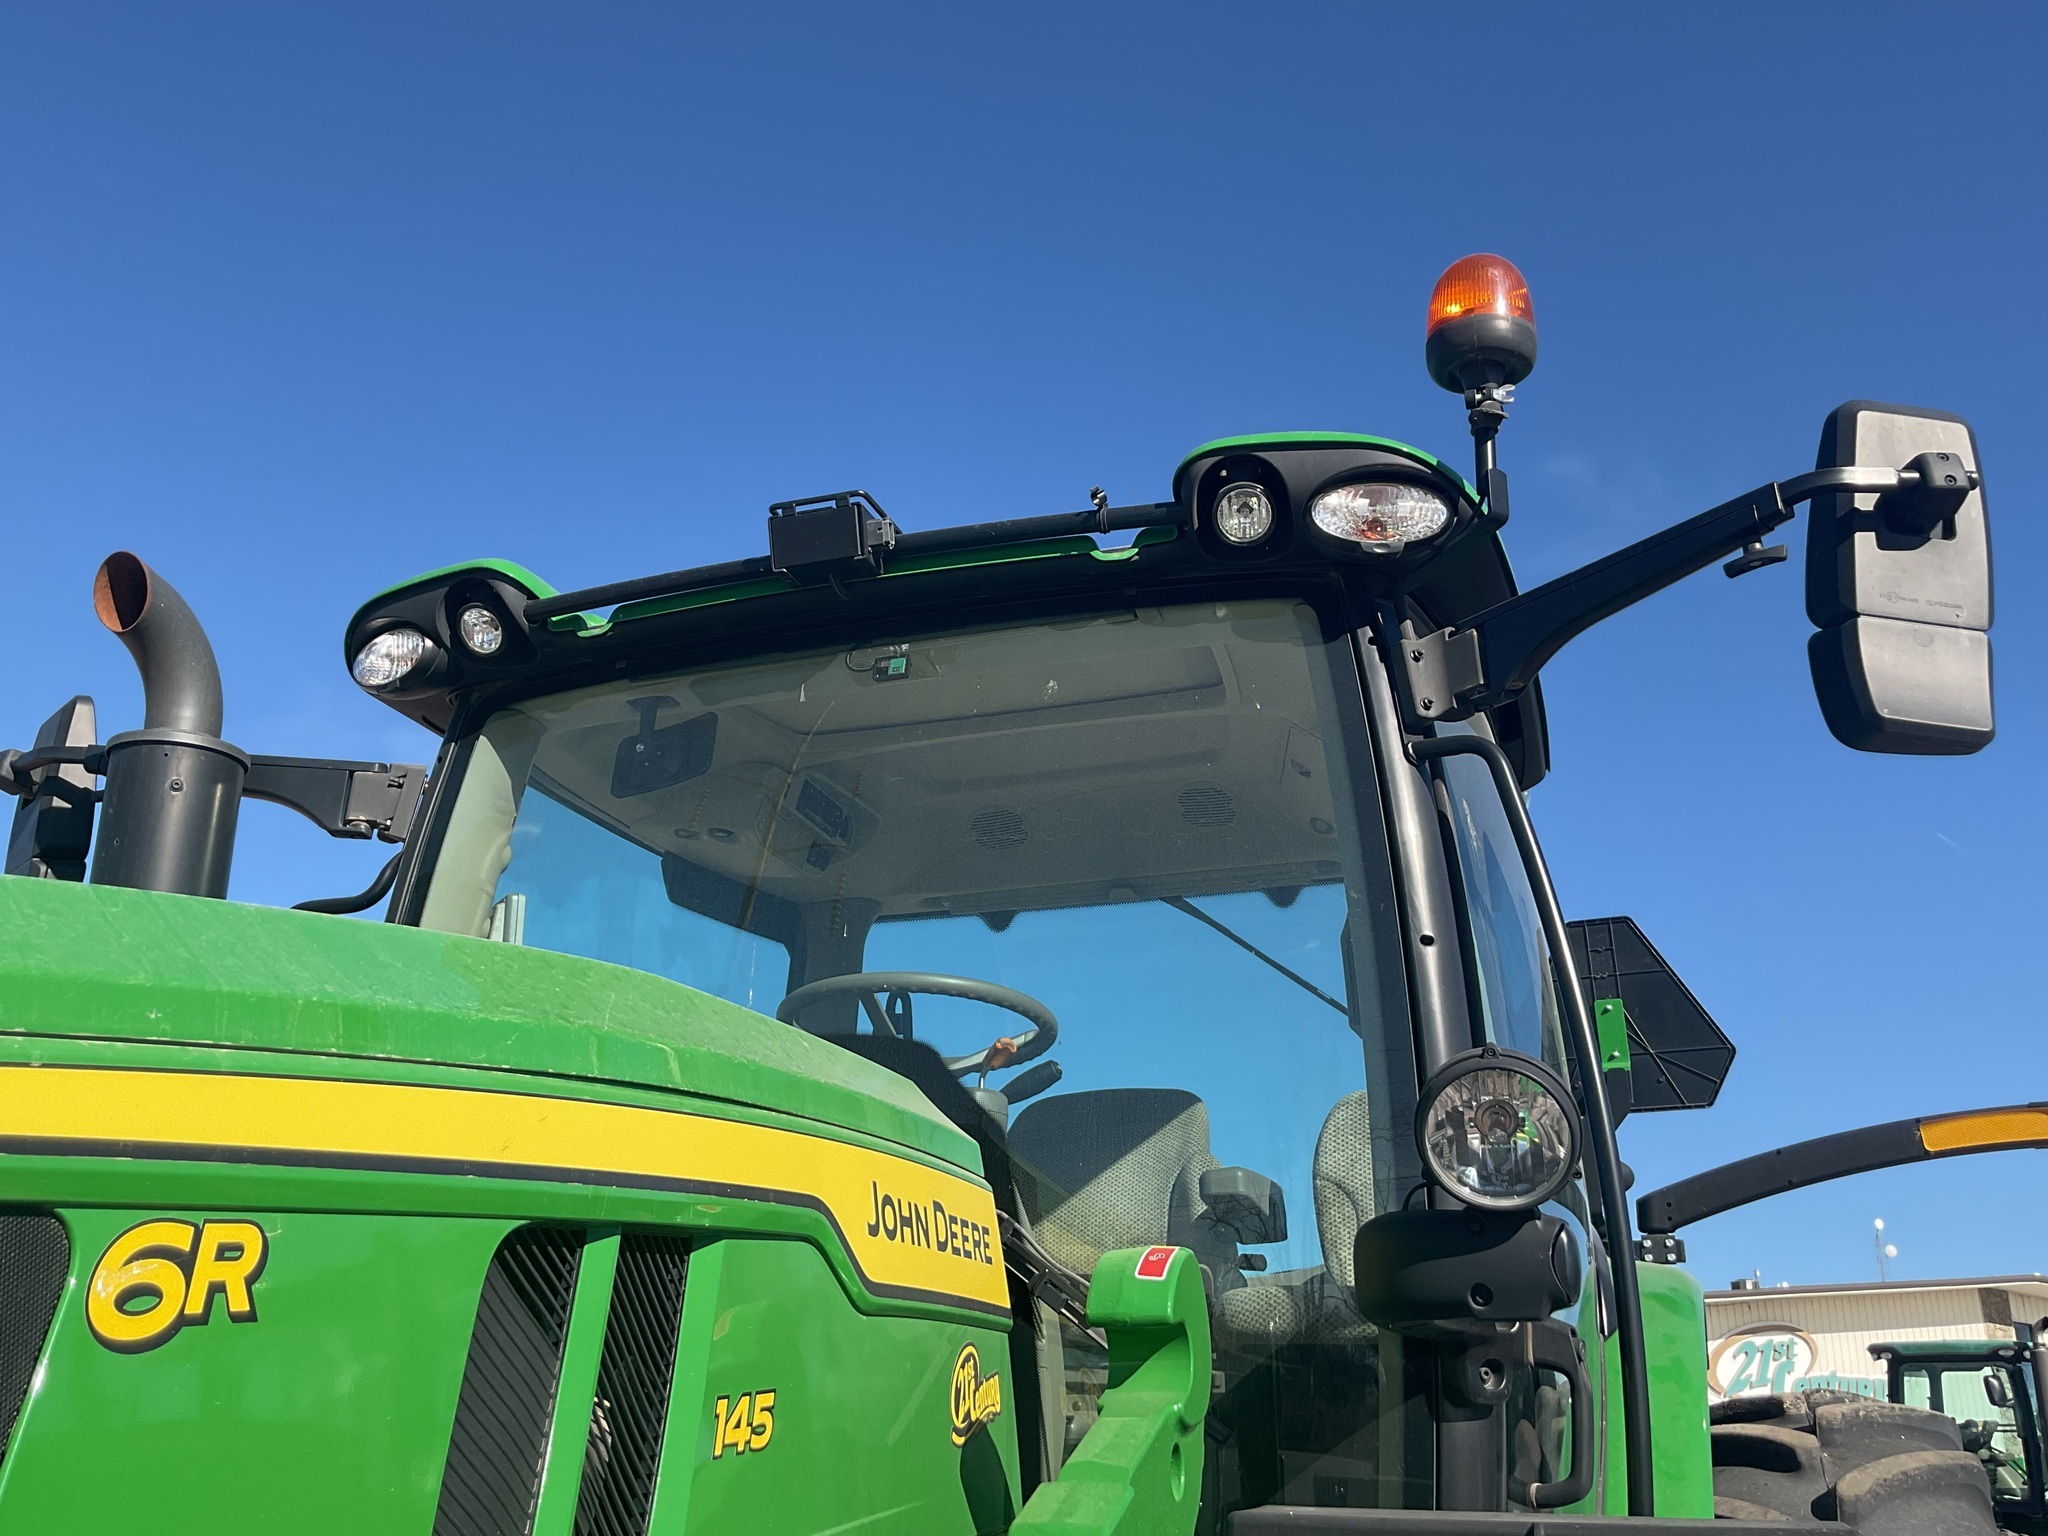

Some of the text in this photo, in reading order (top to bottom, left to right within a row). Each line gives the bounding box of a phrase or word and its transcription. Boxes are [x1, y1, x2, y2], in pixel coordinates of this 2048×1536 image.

[867, 1180, 994, 1266] JOHN DEERE
[86, 1218, 267, 1352] 6R
[1725, 1337, 1799, 1398] 21st
[712, 1388, 777, 1460] 145
